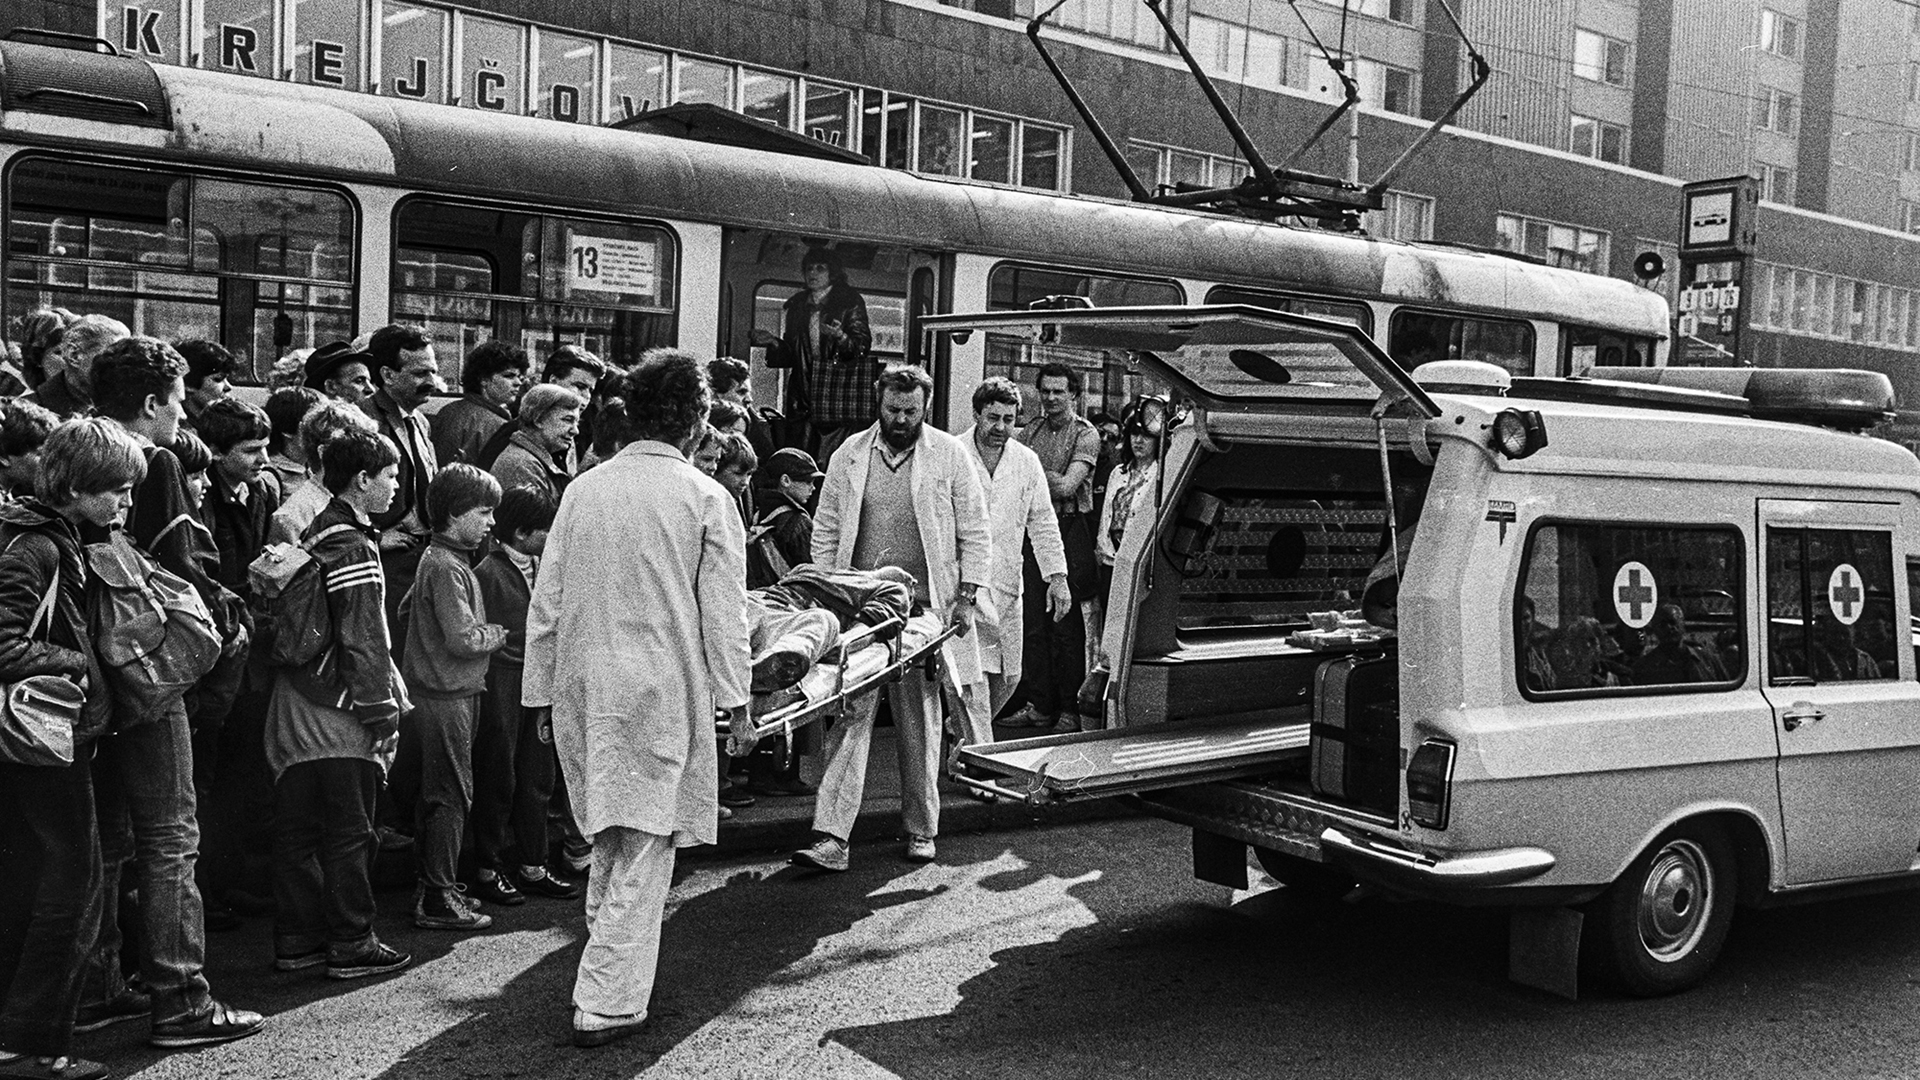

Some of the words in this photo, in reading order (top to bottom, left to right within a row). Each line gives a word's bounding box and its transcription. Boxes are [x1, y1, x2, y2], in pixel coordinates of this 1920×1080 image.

[572, 246, 599, 279] 13
[1704, 291, 1714, 308] 13
[1723, 289, 1735, 306] 26
